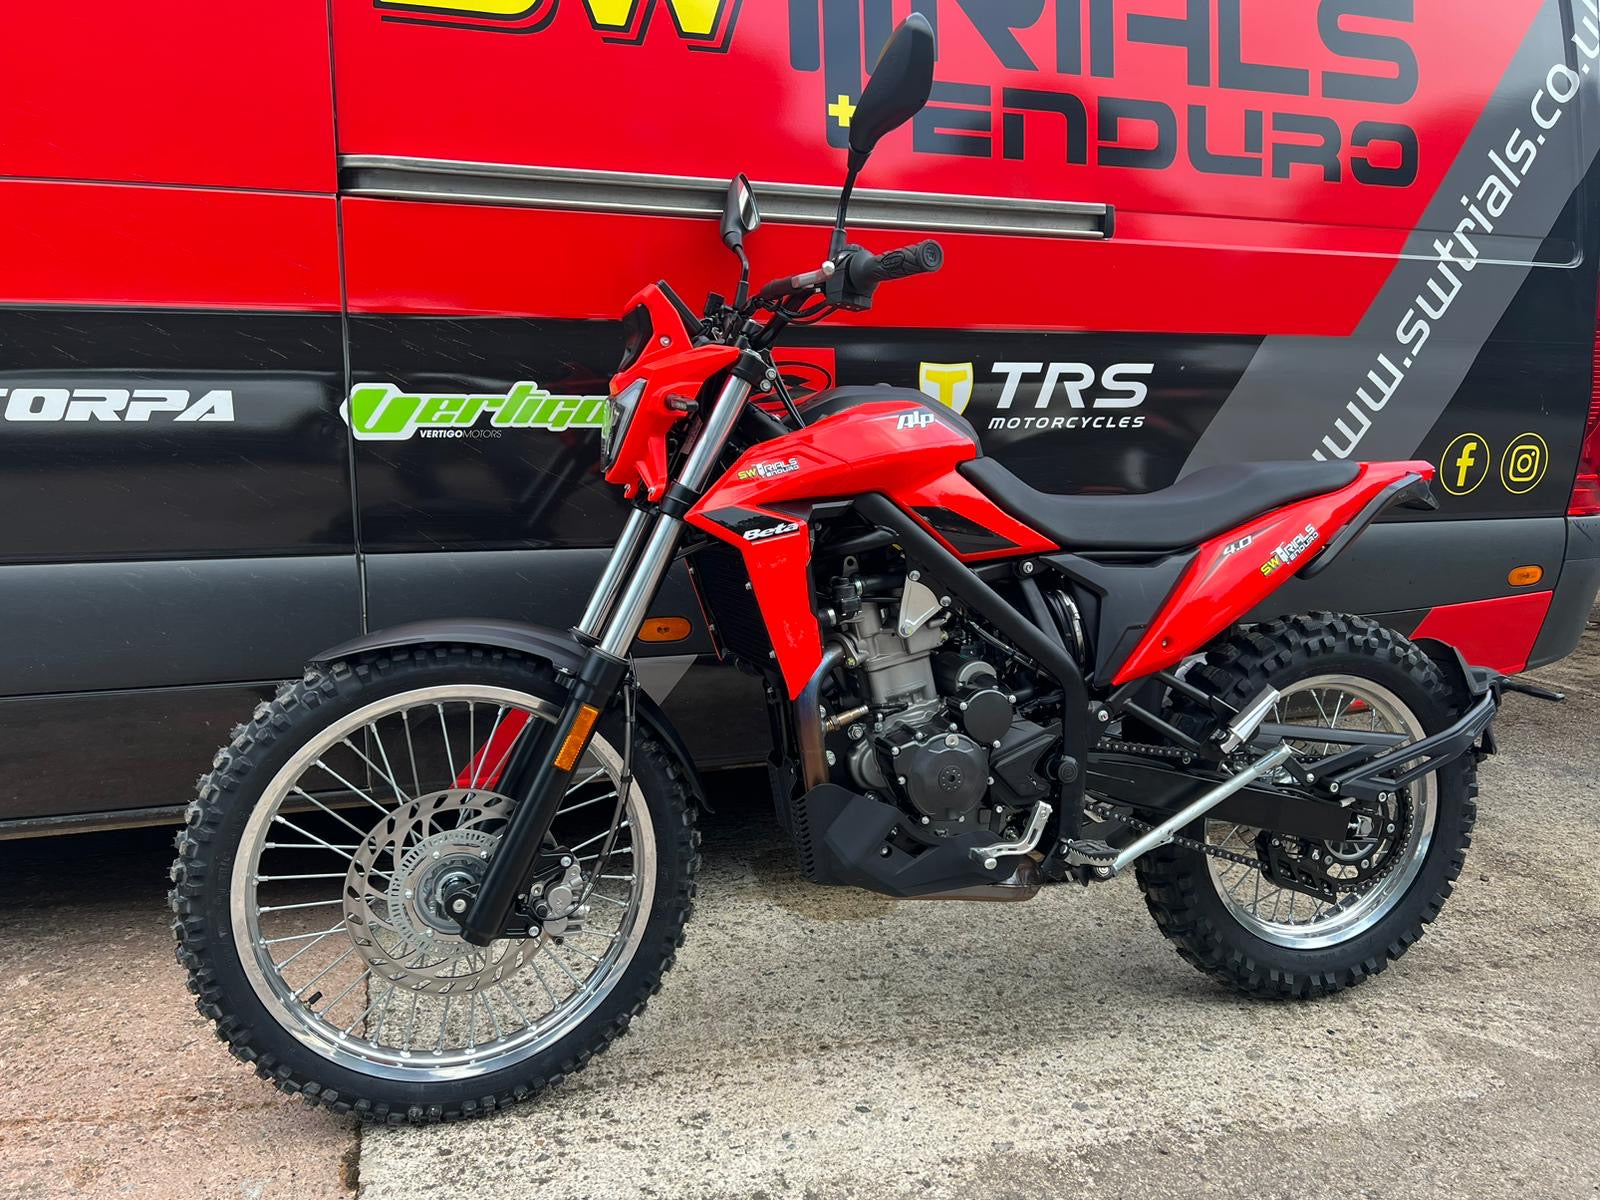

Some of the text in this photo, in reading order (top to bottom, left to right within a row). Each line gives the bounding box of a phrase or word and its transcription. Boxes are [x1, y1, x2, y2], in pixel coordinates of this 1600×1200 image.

[1312, 0, 1599, 461] ww.swtrials.co.u
[990, 362, 1154, 408] TRS
[988, 416, 1145, 429] MOTORCYCLES
[737, 468, 757, 480] SW
[743, 522, 799, 541] Beta
[1223, 535, 1252, 555] 4.0
[1260, 555, 1281, 576] SW
